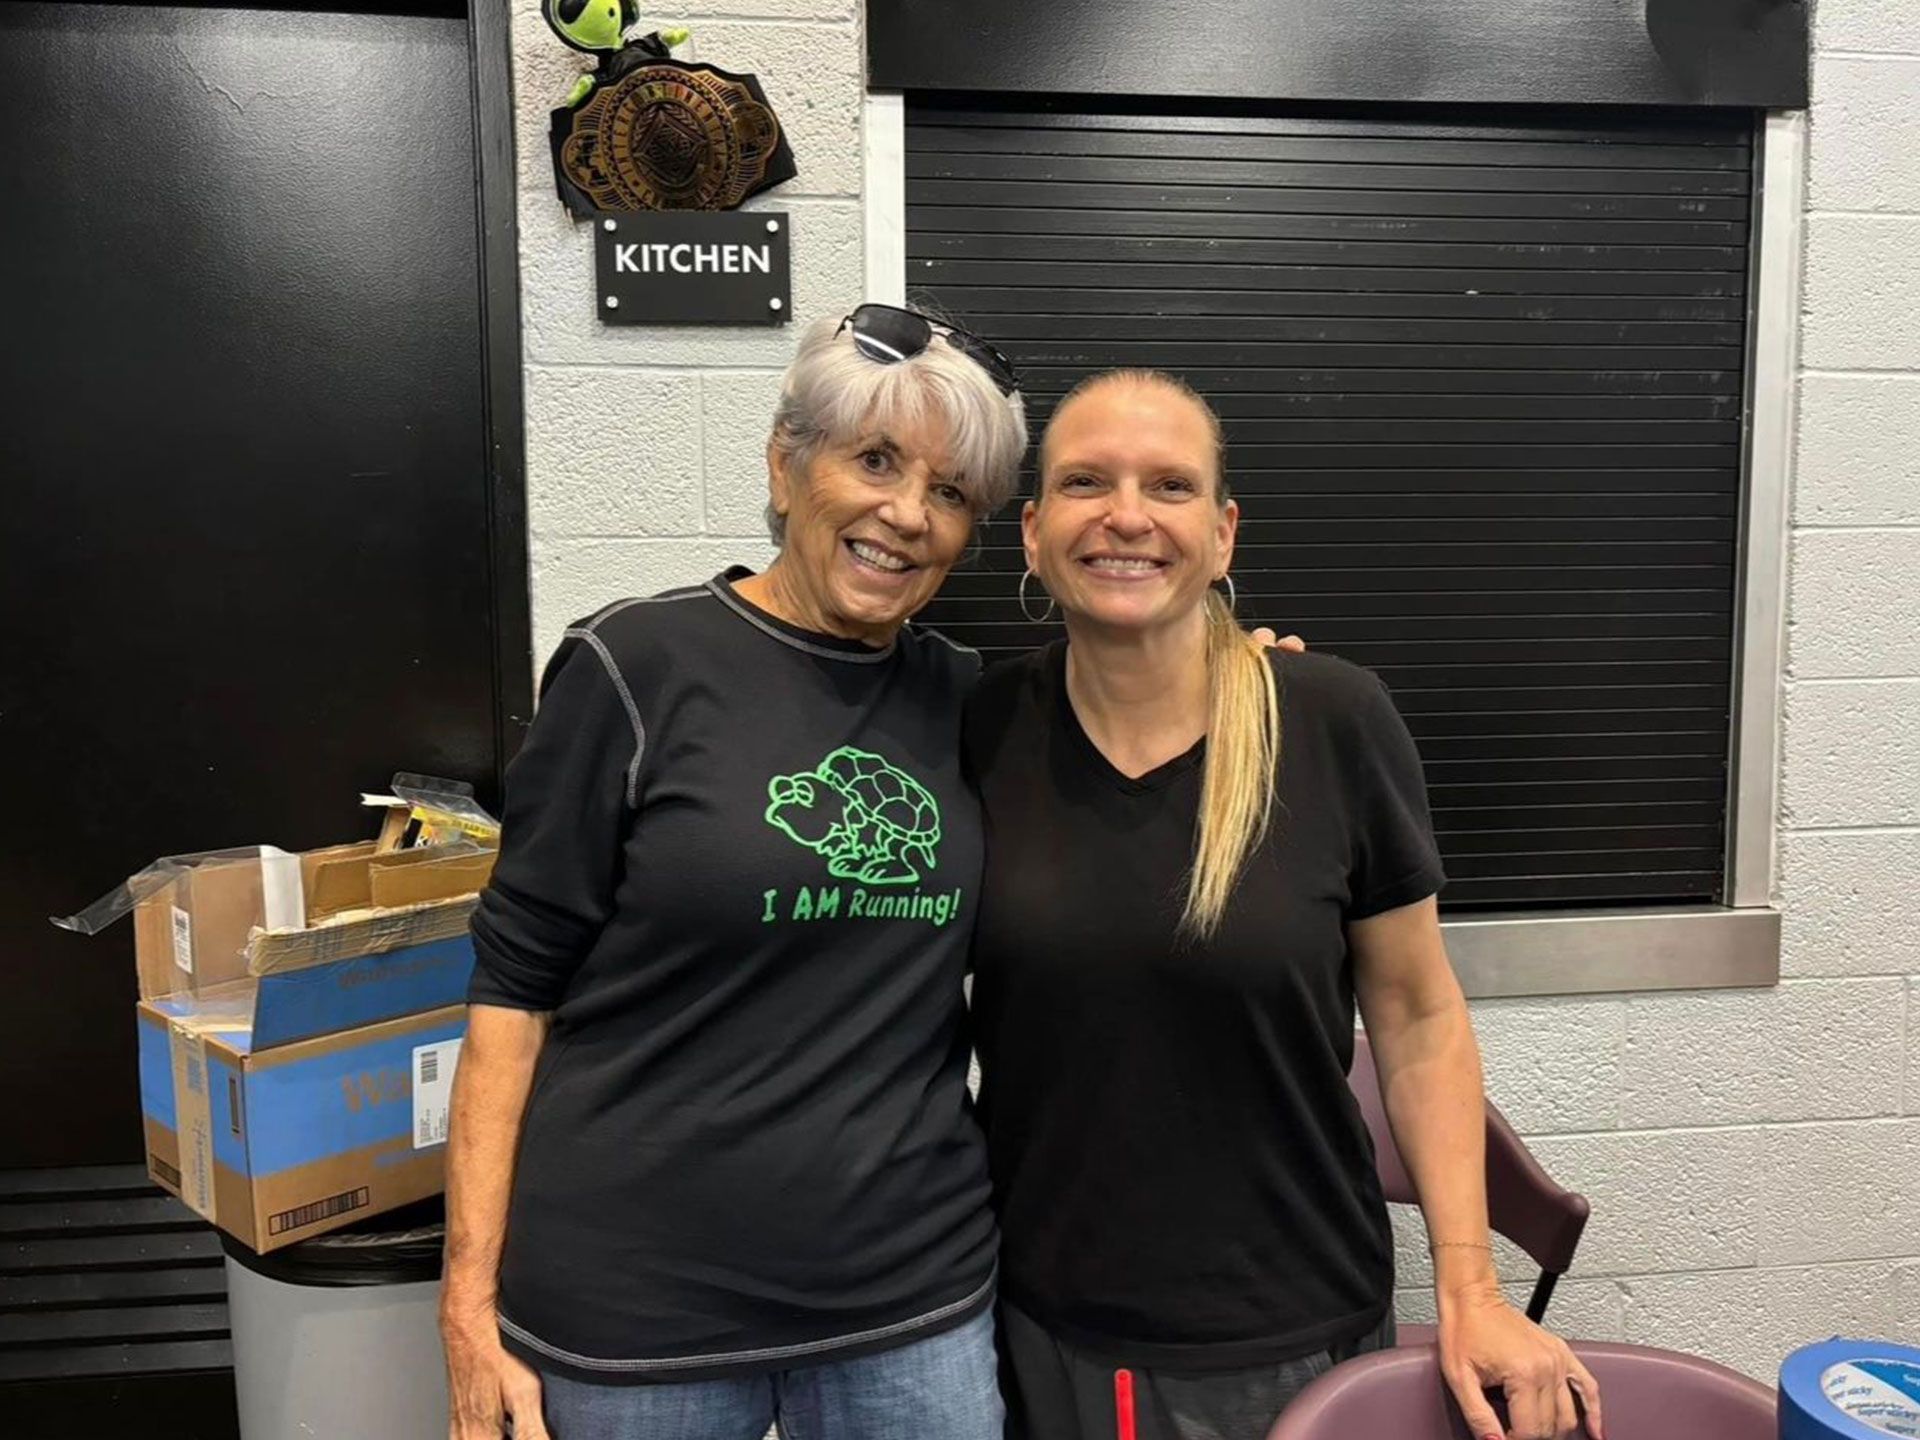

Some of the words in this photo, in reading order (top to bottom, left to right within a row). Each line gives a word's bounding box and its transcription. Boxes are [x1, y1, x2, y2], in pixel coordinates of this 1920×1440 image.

[615, 244, 770, 273] KITCHEN
[762, 889, 777, 922] I
[792, 886, 841, 921] AM
[848, 886, 962, 926] Running!
